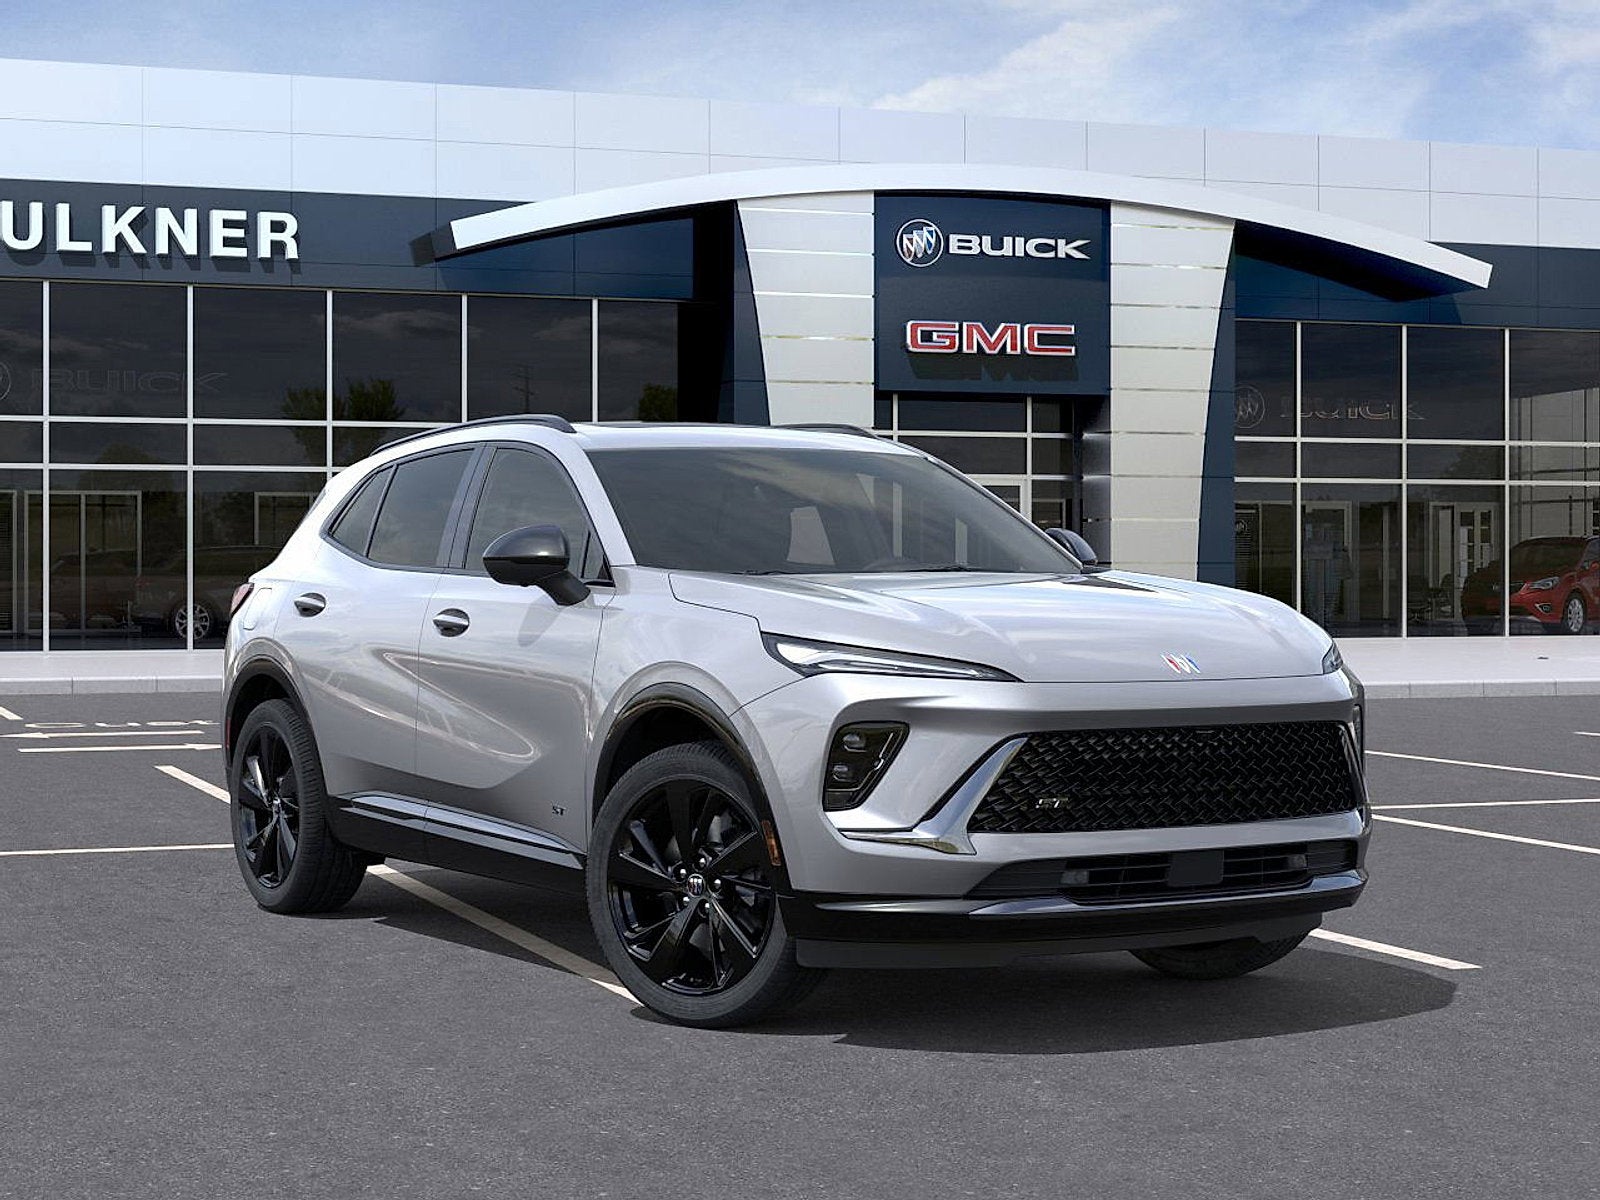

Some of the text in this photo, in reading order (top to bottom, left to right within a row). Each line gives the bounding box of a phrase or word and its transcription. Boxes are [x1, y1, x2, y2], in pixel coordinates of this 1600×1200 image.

[0, 200, 299, 259] ULKNER
[949, 234, 1091, 259] BUICK
[906, 320, 1076, 356] GMC
[551, 806, 566, 816] ST
